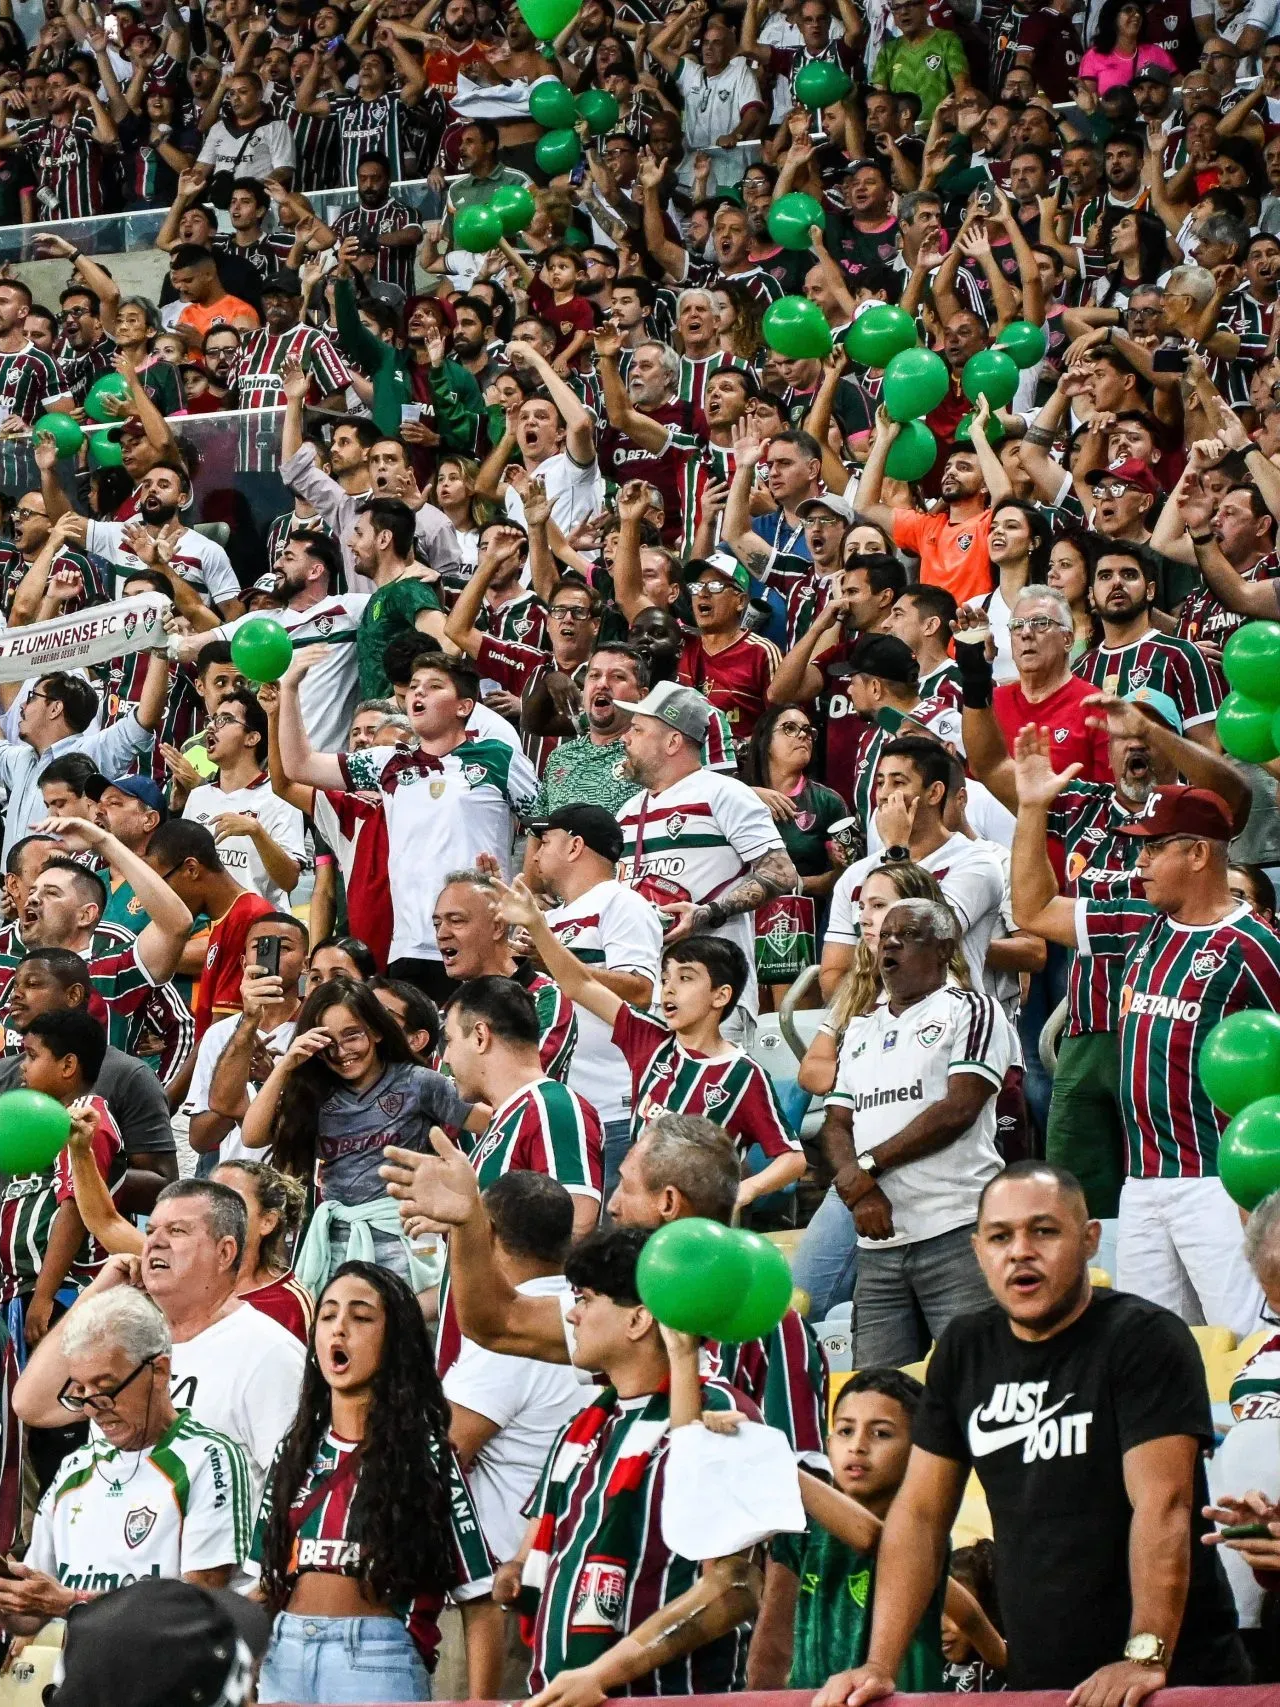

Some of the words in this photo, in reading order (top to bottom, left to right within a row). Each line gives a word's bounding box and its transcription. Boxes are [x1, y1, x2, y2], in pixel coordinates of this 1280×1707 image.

[344, 126, 384, 139] SUPERBET
[239, 375, 283, 391] Unime
[627, 450, 661, 460] BETA
[9, 621, 97, 657] FLUMINENSE
[100, 616, 117, 638] FC
[60, 648, 77, 660] DESDE
[1130, 991, 1201, 1022] BETANO
[855, 1079, 924, 1112] Unimed
[831, 1337, 841, 1351] 06
[980, 1381, 1050, 1423] JUST
[1060, 1412, 1093, 1457] IT
